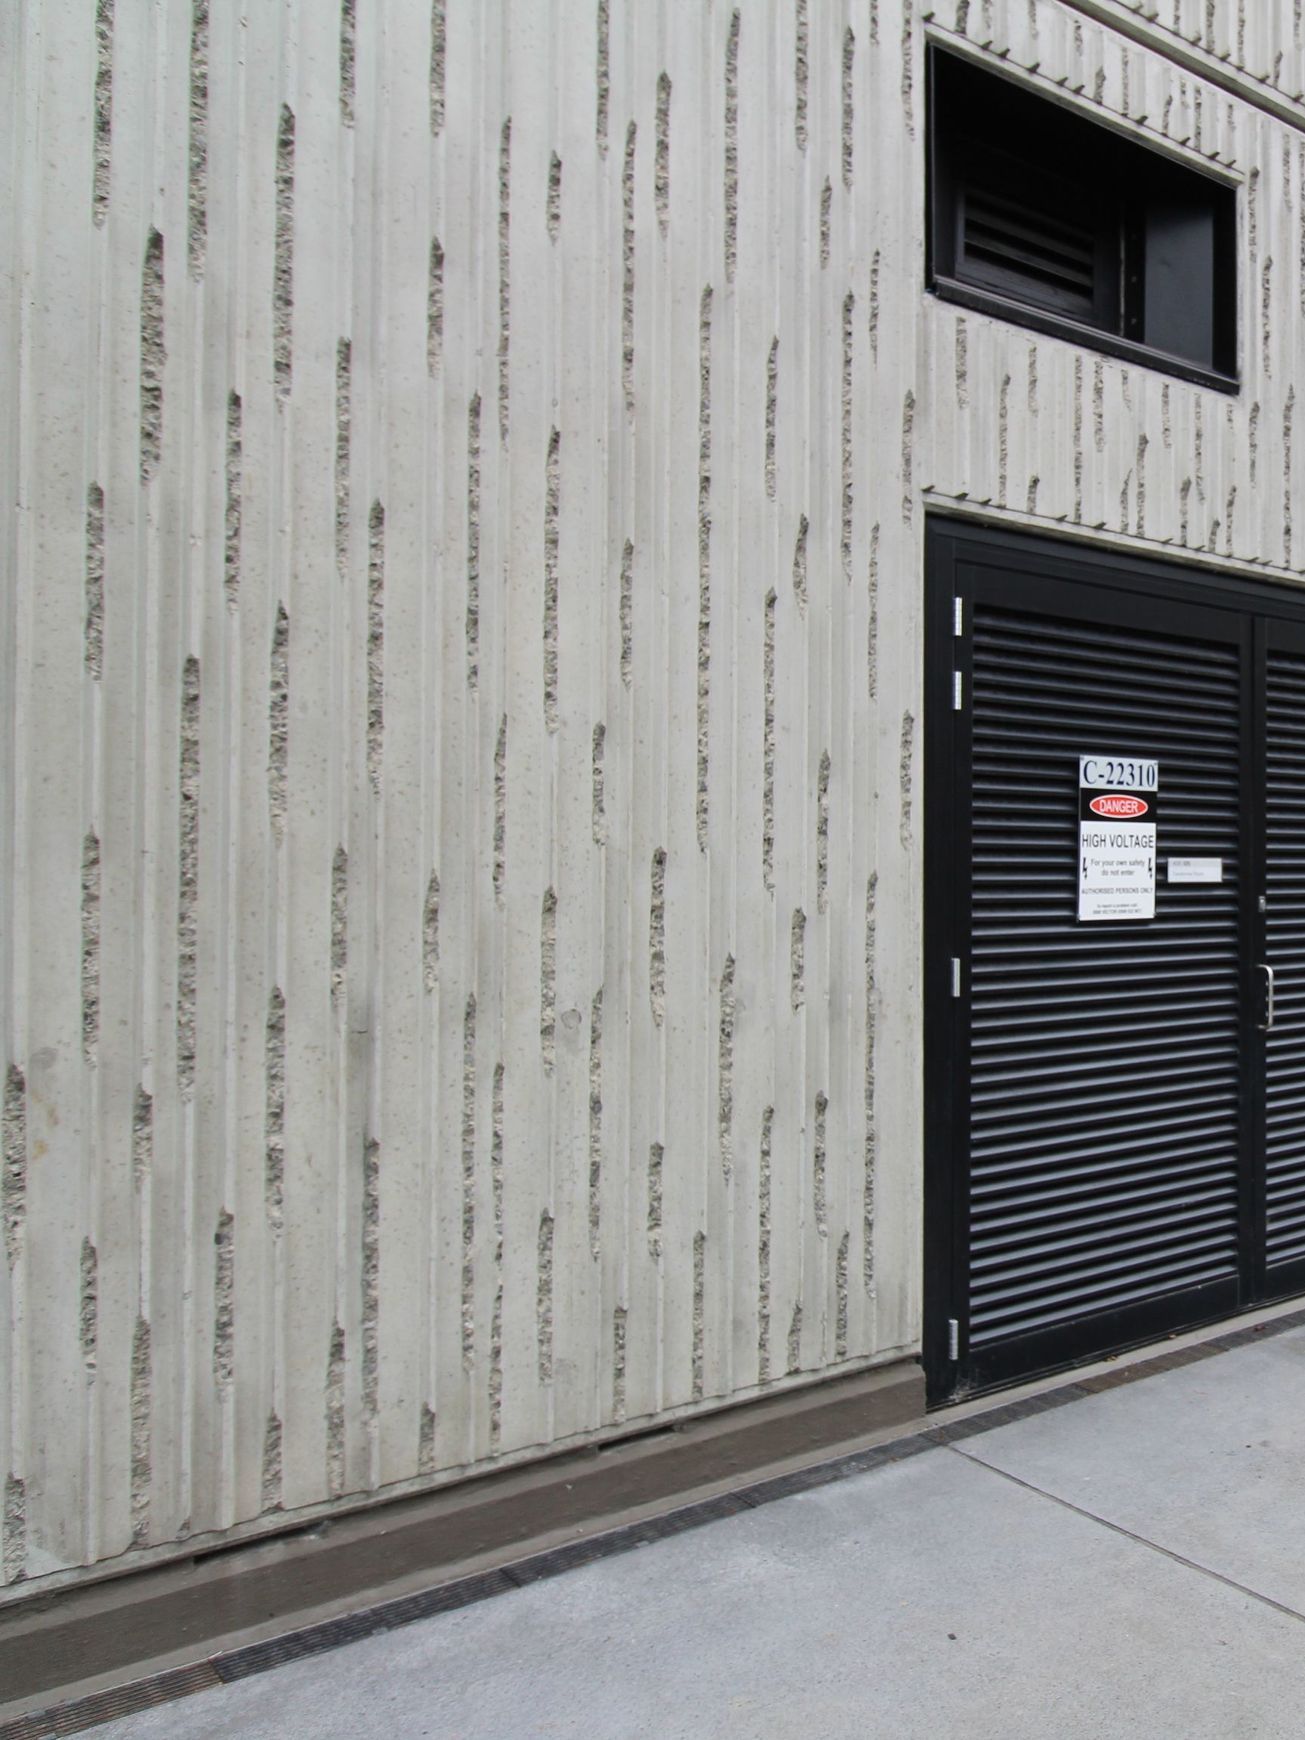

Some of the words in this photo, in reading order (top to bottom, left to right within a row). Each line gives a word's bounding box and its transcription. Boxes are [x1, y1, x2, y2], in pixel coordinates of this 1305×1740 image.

[1083, 760, 1156, 787] C-22310
[1099, 799, 1139, 813] DANGER
[1082, 834, 1106, 848] HIGH
[1109, 834, 1154, 848] VOLTAGE
[1102, 860, 1114, 868] your
[1129, 859, 1145, 868] safety
